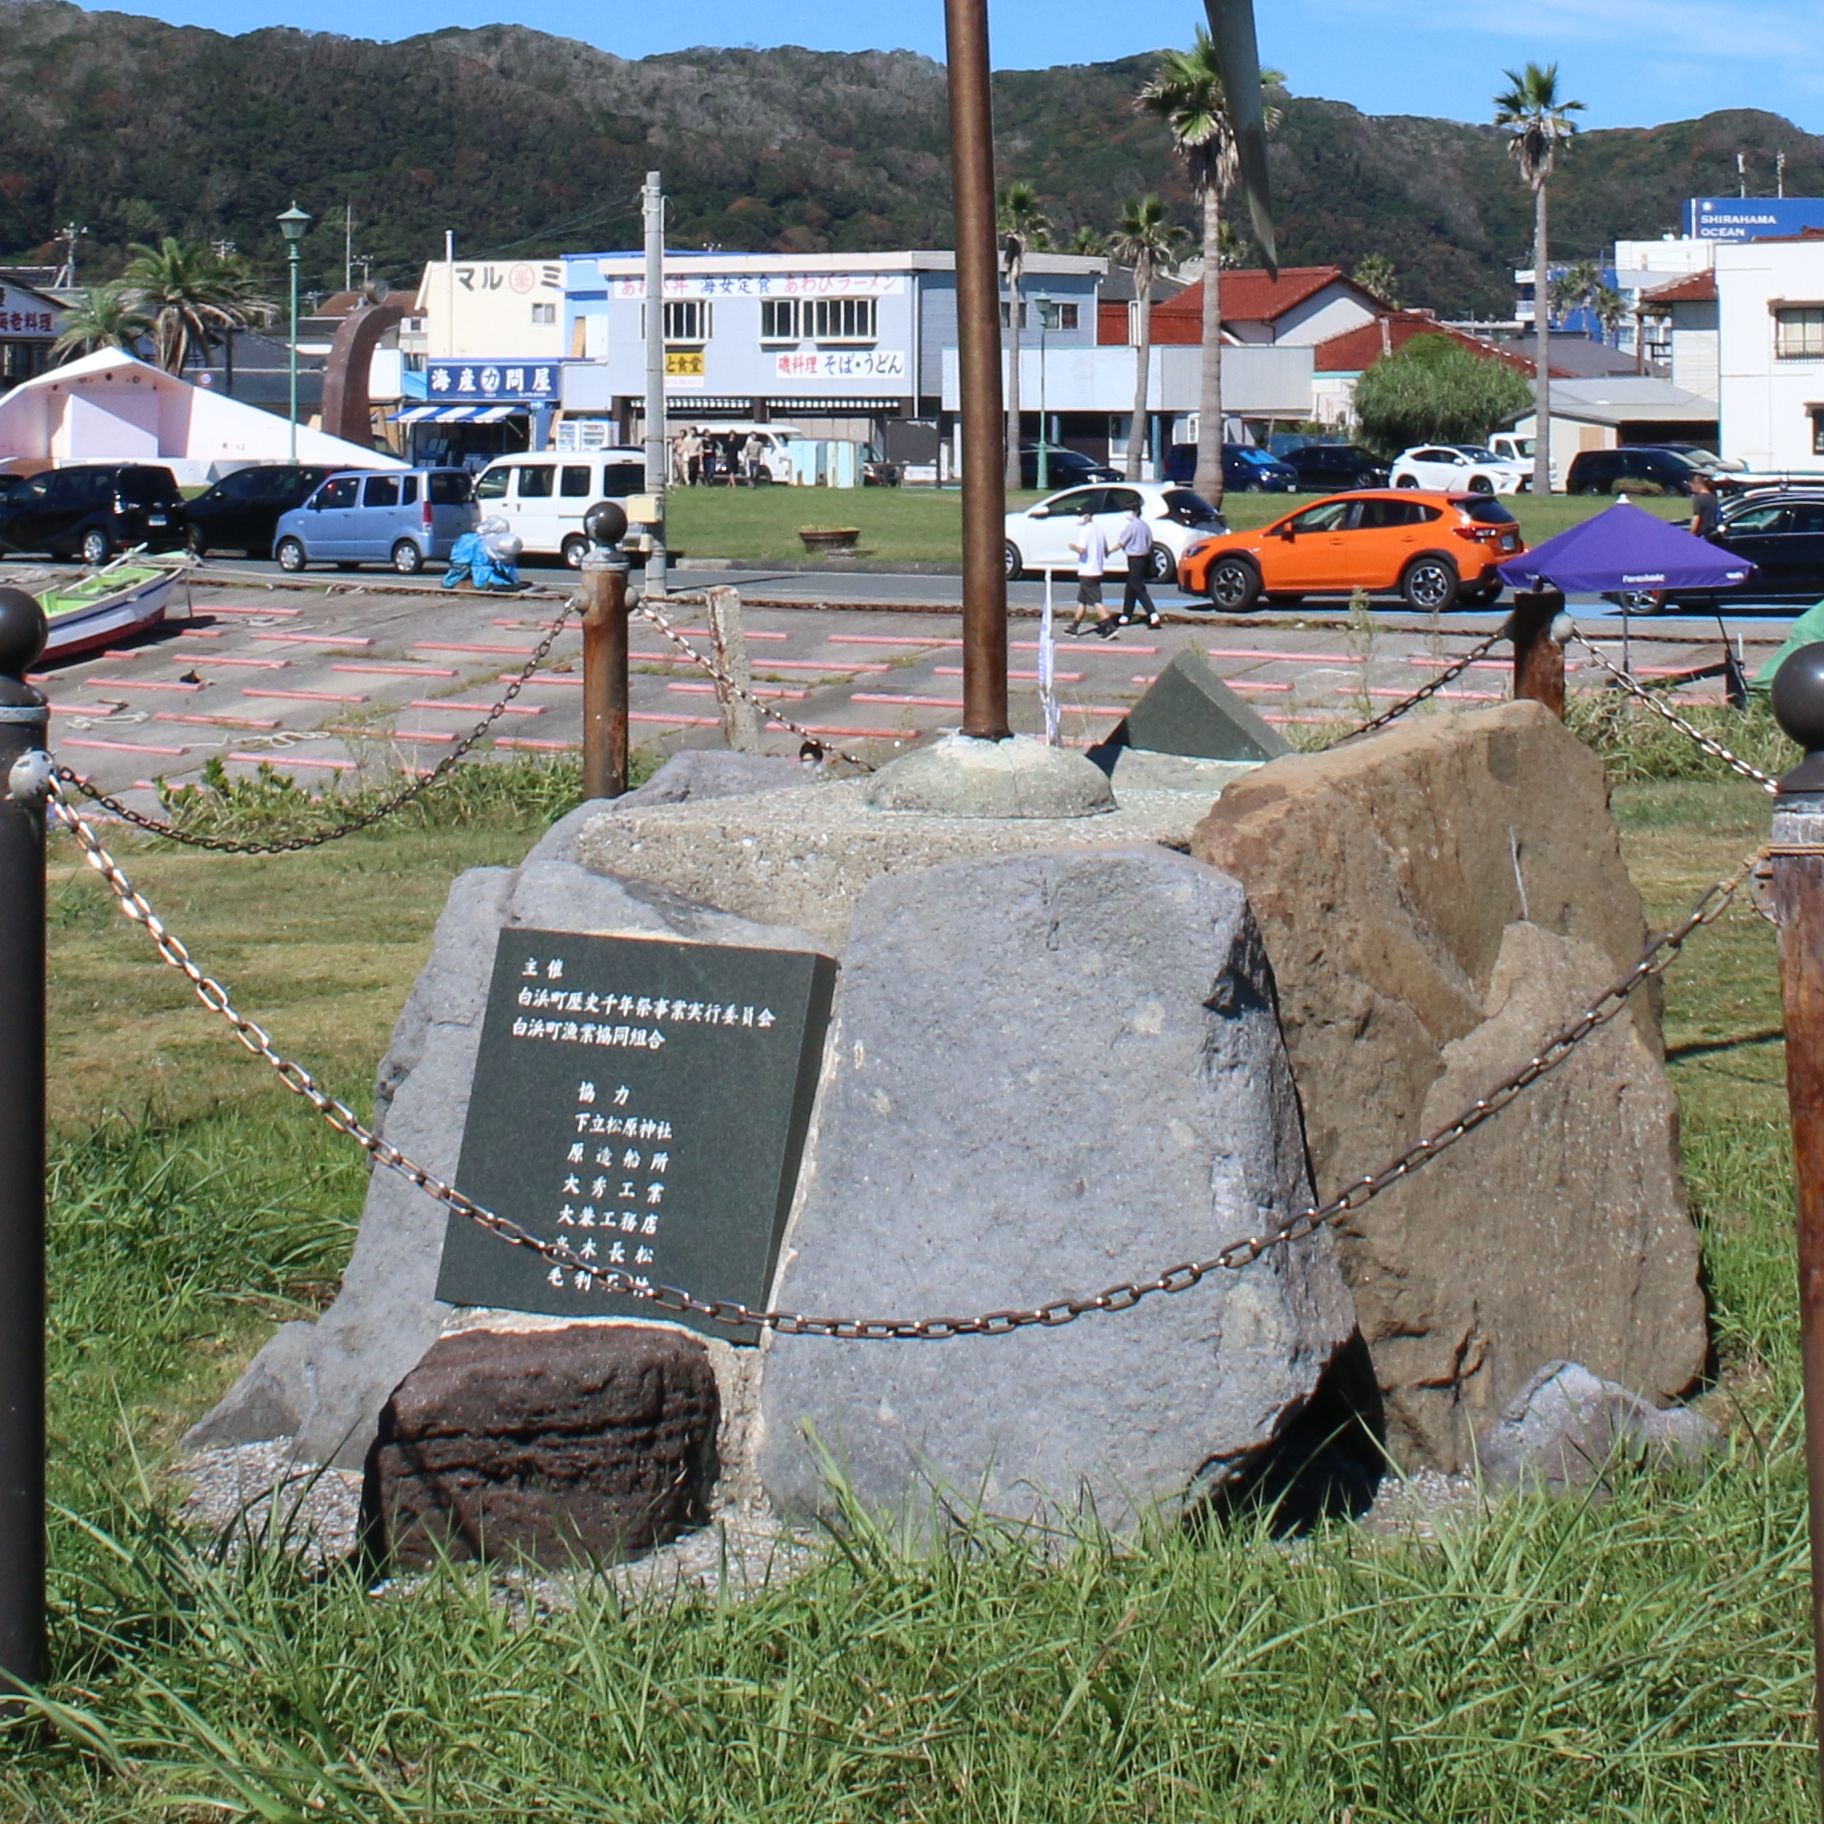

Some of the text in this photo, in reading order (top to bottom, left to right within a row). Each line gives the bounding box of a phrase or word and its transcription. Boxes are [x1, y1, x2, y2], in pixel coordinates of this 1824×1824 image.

[1700, 214, 1776, 224] SHIRAHAMA
[1700, 227, 1745, 237] OCEAN
[700, 275, 771, 295] 海女定食
[784, 273, 897, 294] あわびラーメン
[778, 354, 818, 375] 磯料理
[521, 956, 564, 980] 主催
[511, 1015, 666, 1050] 白浜町漁業協同組合
[578, 1080, 631, 1106] 協力
[574, 1111, 674, 1141] 下立松原神社
[566, 1142, 670, 1174] 原造船所
